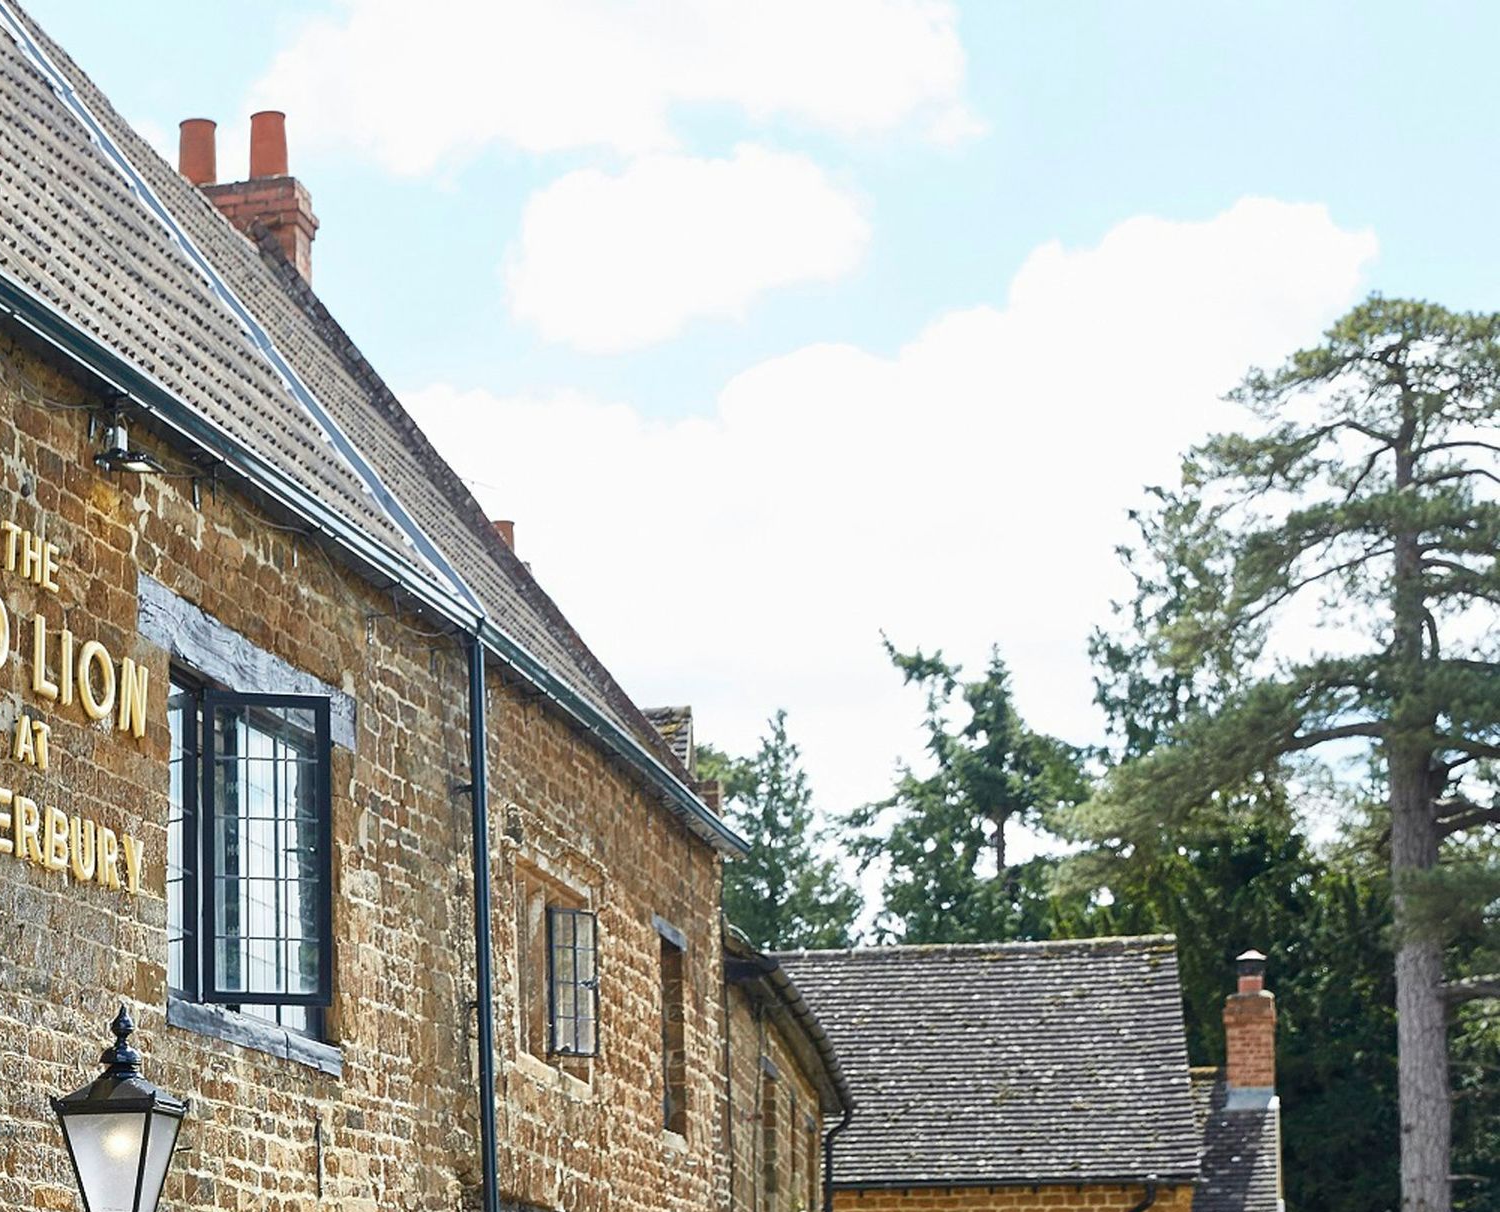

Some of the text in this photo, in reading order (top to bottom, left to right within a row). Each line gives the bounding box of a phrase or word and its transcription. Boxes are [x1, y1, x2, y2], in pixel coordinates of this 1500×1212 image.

[1, 520, 60, 593] THE
[32, 613, 149, 739] LION
[13, 714, 51, 770] AT
